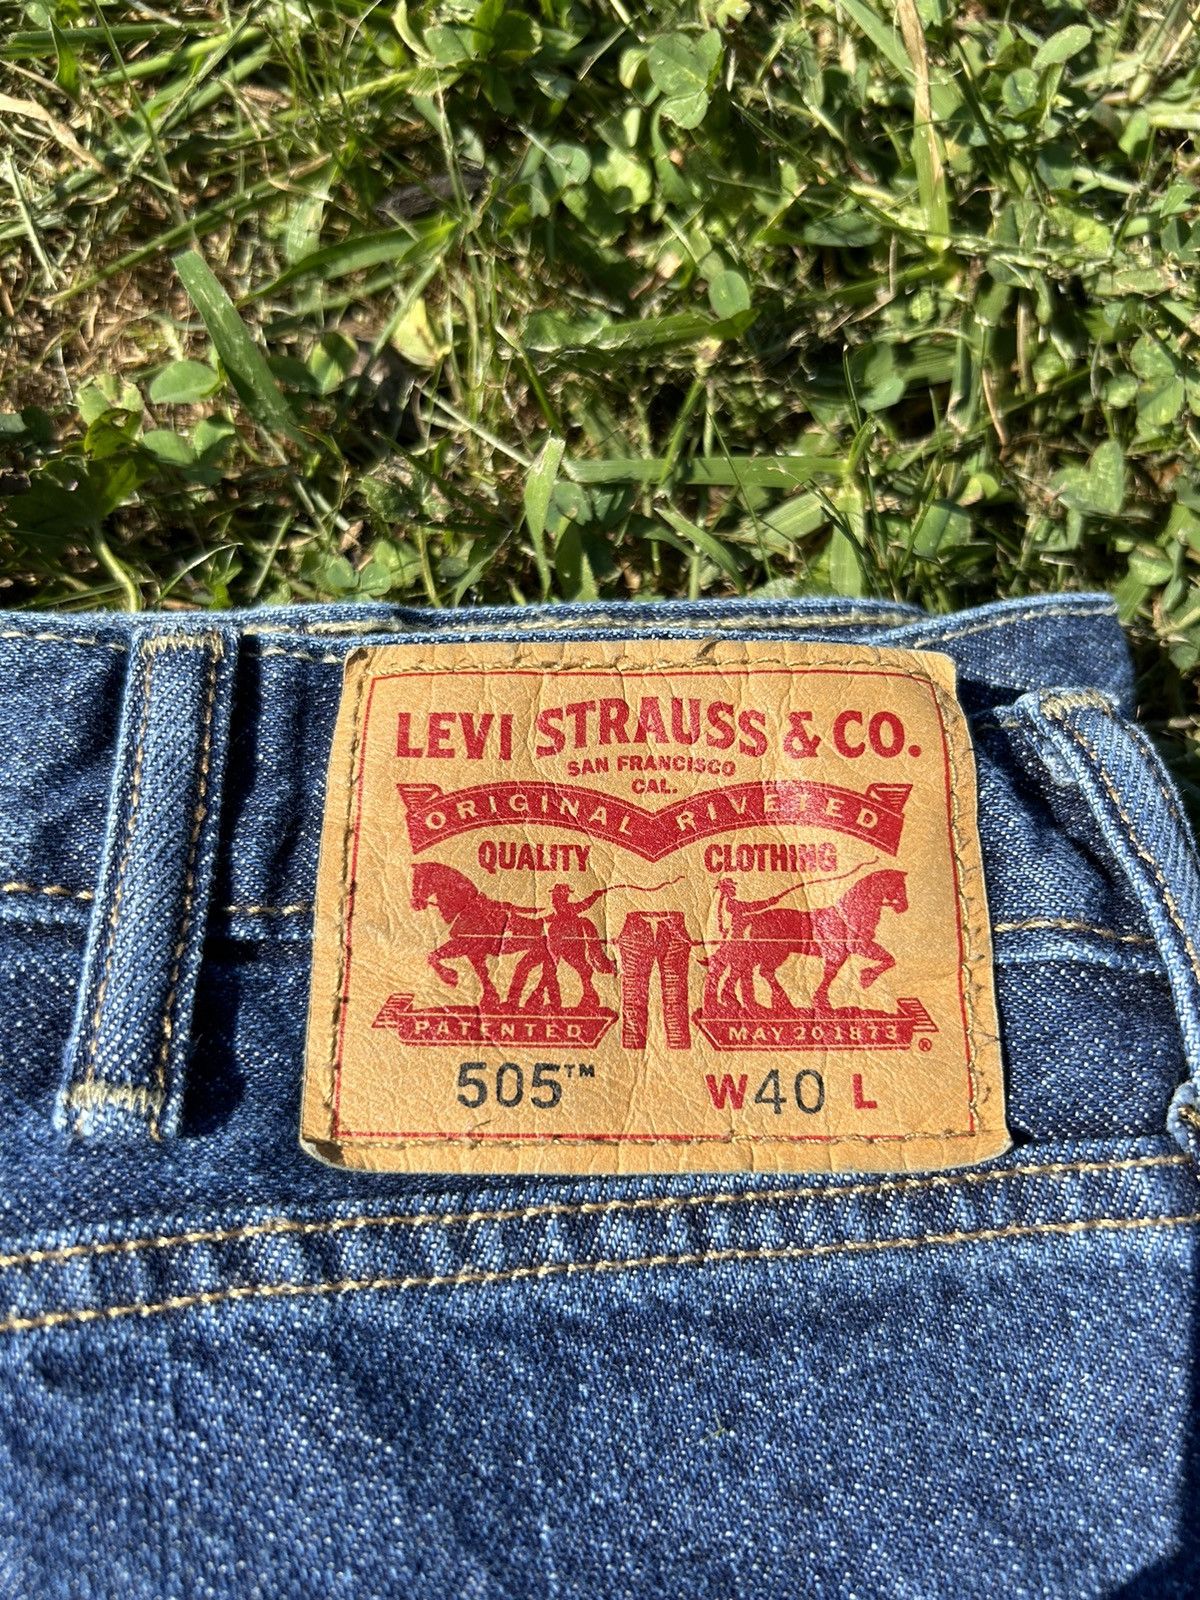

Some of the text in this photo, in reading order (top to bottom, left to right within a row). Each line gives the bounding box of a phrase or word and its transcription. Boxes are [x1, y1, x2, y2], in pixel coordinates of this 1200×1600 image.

[396, 697, 922, 759] LEVI STRAUSS & CO.
[566, 755, 736, 777] SAN FRANCISCO
[632, 777, 678, 796] CAL.
[425, 794, 879, 835] ORIGINAL RIVETED
[478, 841, 838, 874] QUALITY CLOTHING
[414, 1019, 582, 1039] PATENTED
[728, 1026, 784, 1042] MAY
[834, 1026, 899, 1042] 1873
[853, 1074, 878, 1110] L
